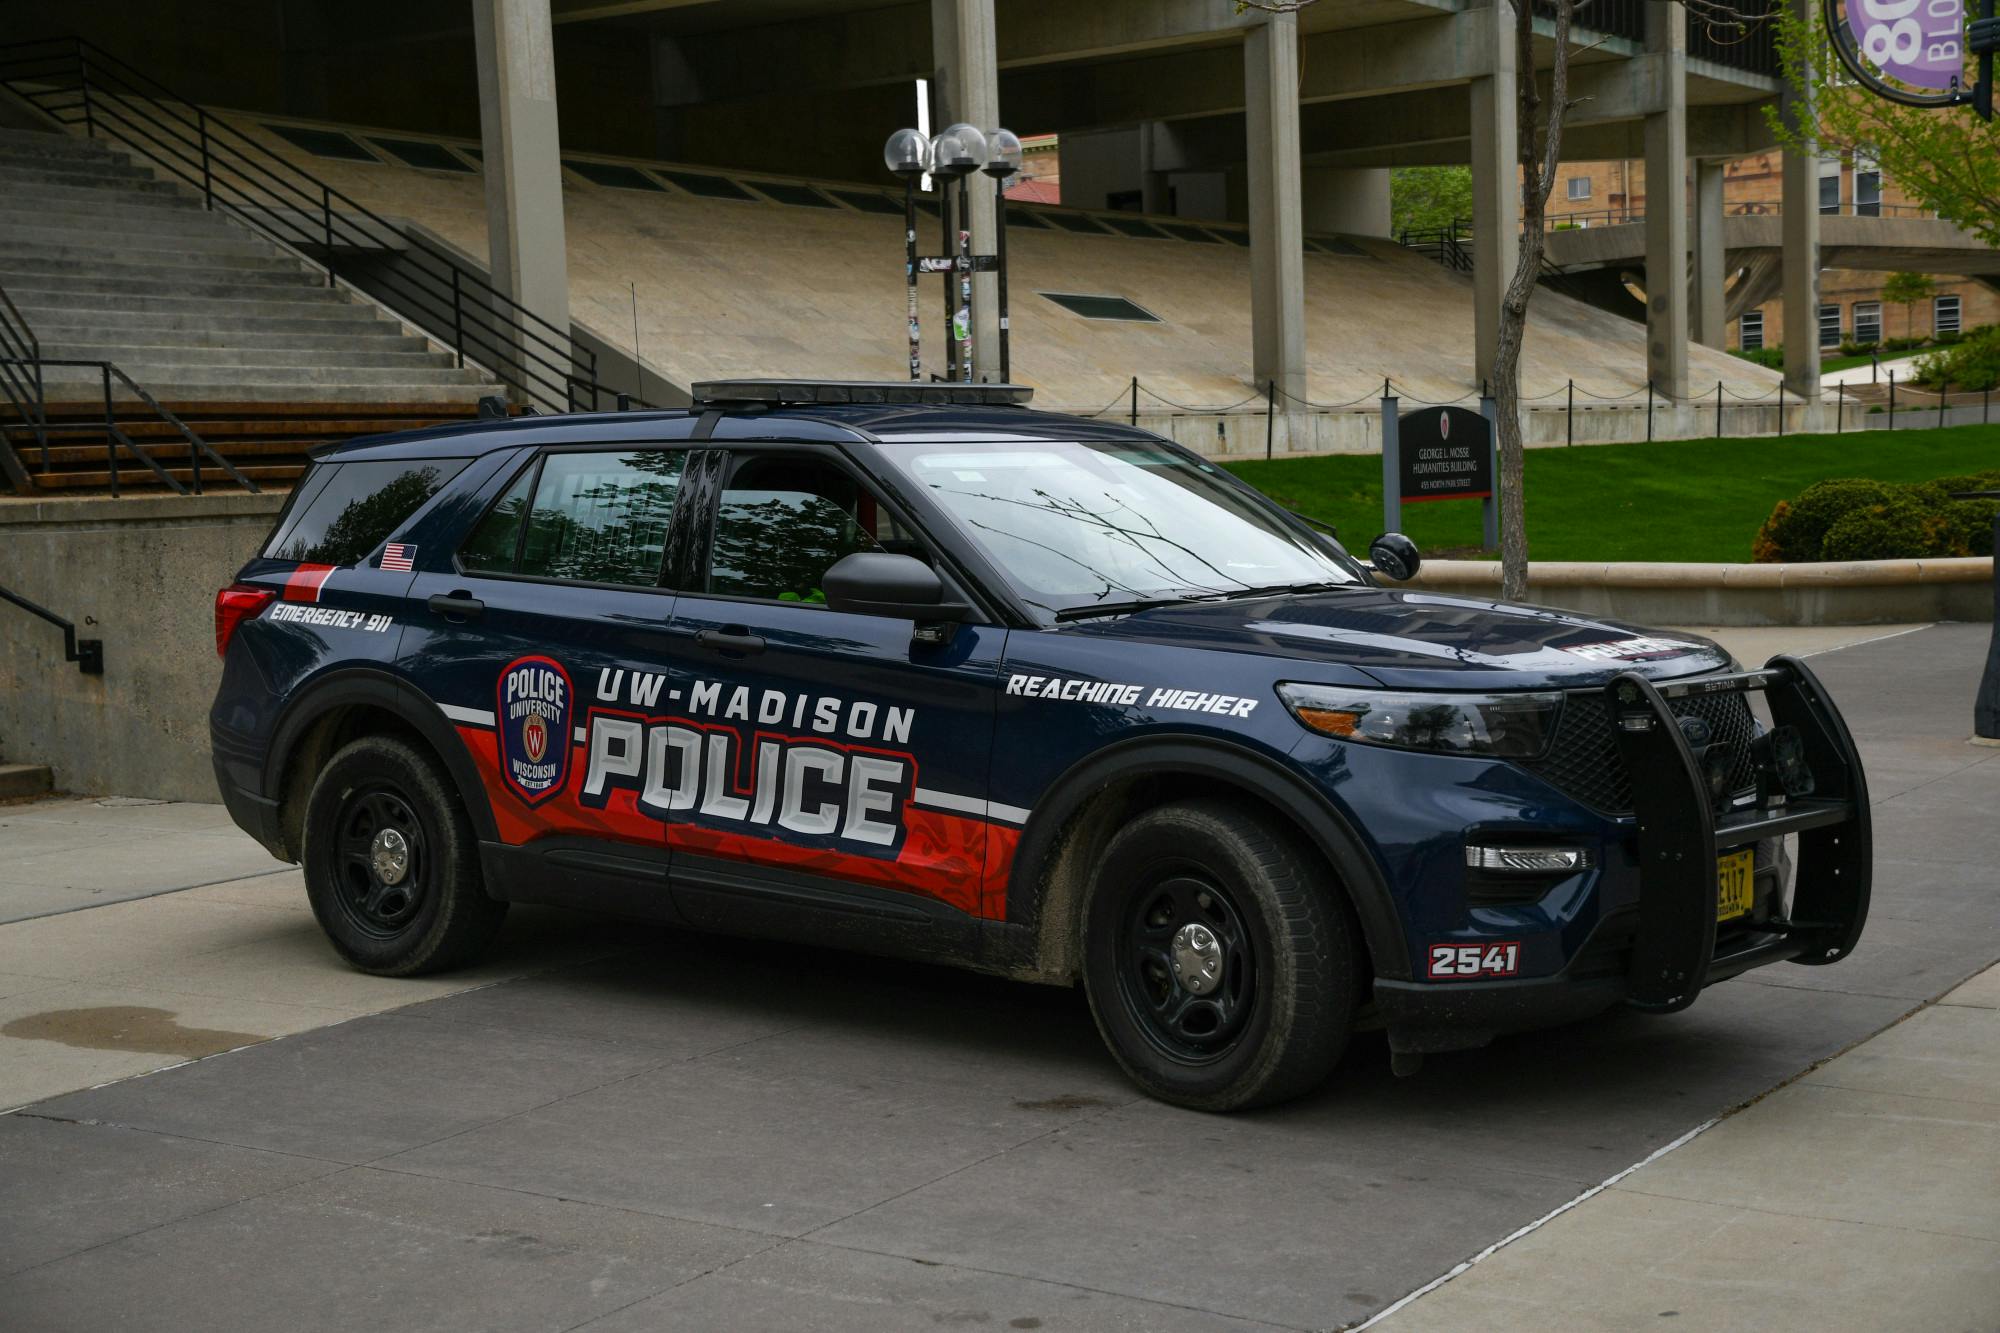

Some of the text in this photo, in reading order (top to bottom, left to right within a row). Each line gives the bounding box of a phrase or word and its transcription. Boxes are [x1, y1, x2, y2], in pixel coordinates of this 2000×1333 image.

[1412, 460, 1477, 474] HUMANITIES BUILDING
[1418, 448, 1443, 460] GEORGE
[1450, 447, 1470, 458] MOSSE
[1456, 478, 1471, 487] STREET
[270, 603, 393, 633] EMERGENCY 911
[507, 668, 565, 709] POLICE
[1006, 674, 1258, 718] REACHING HIGHER
[510, 699, 561, 725] UNIVERSITY
[596, 667, 915, 744] UW-MADISON
[528, 729, 542, 755] W
[512, 758, 556, 779] WISCONSIN
[583, 716, 905, 847] POLICE
[1432, 945, 1518, 974] 2541
